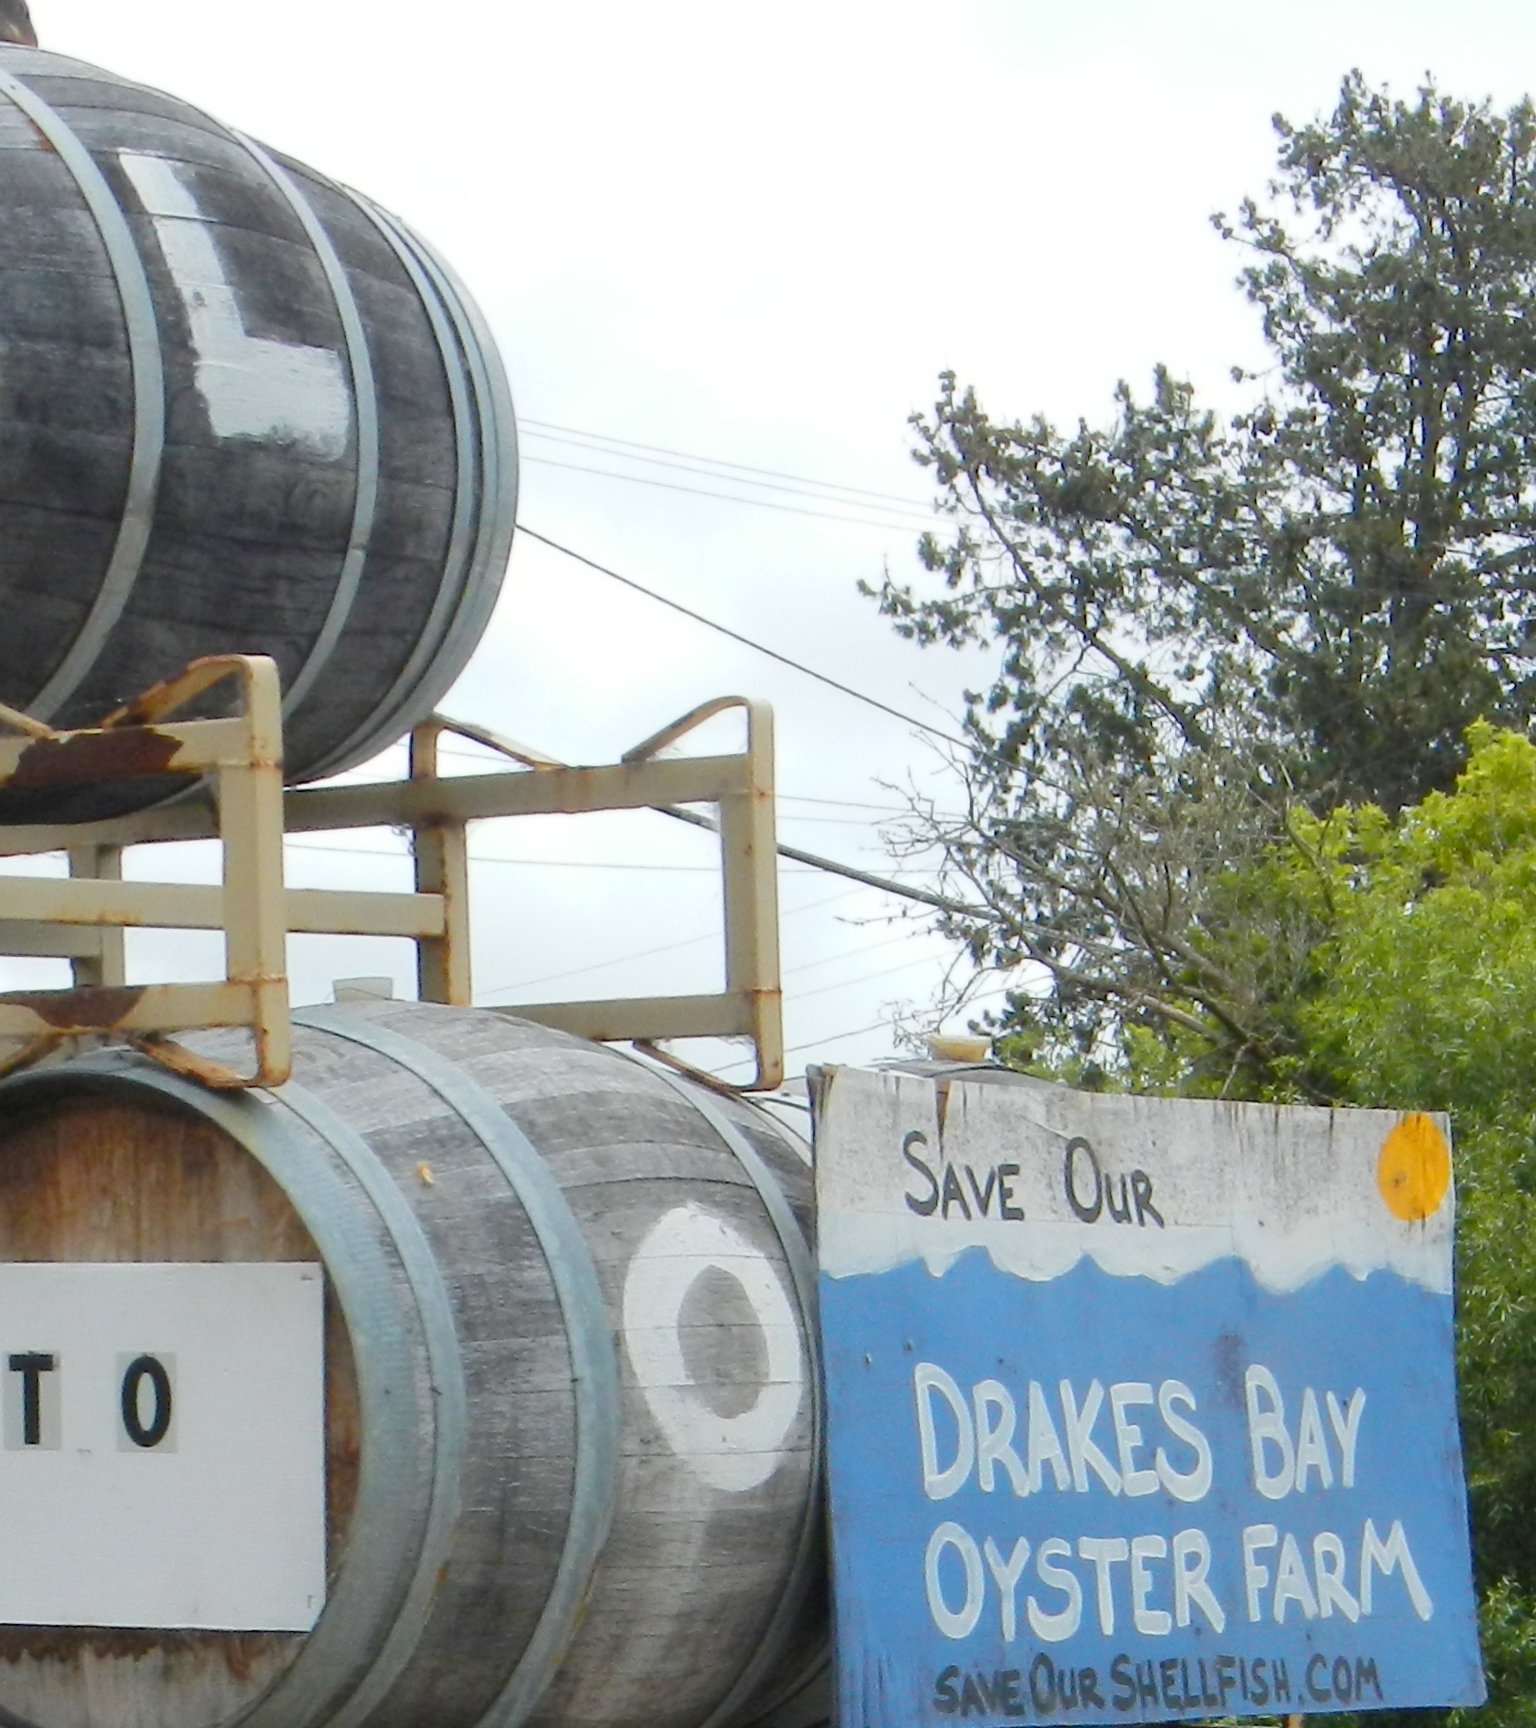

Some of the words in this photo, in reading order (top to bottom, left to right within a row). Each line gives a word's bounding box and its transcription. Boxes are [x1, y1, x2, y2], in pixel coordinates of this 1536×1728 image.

[118, 147, 351, 463] L
[902, 1129, 1026, 1222] SAVE
[1063, 1136, 1164, 1228] OUR
[622, 1200, 803, 1493] O
[912, 1361, 1213, 1503] DRAKES
[1244, 1363, 1367, 1500] BAY
[924, 1520, 1226, 1643] OYSTER
[1243, 1518, 1435, 1625] FARM
